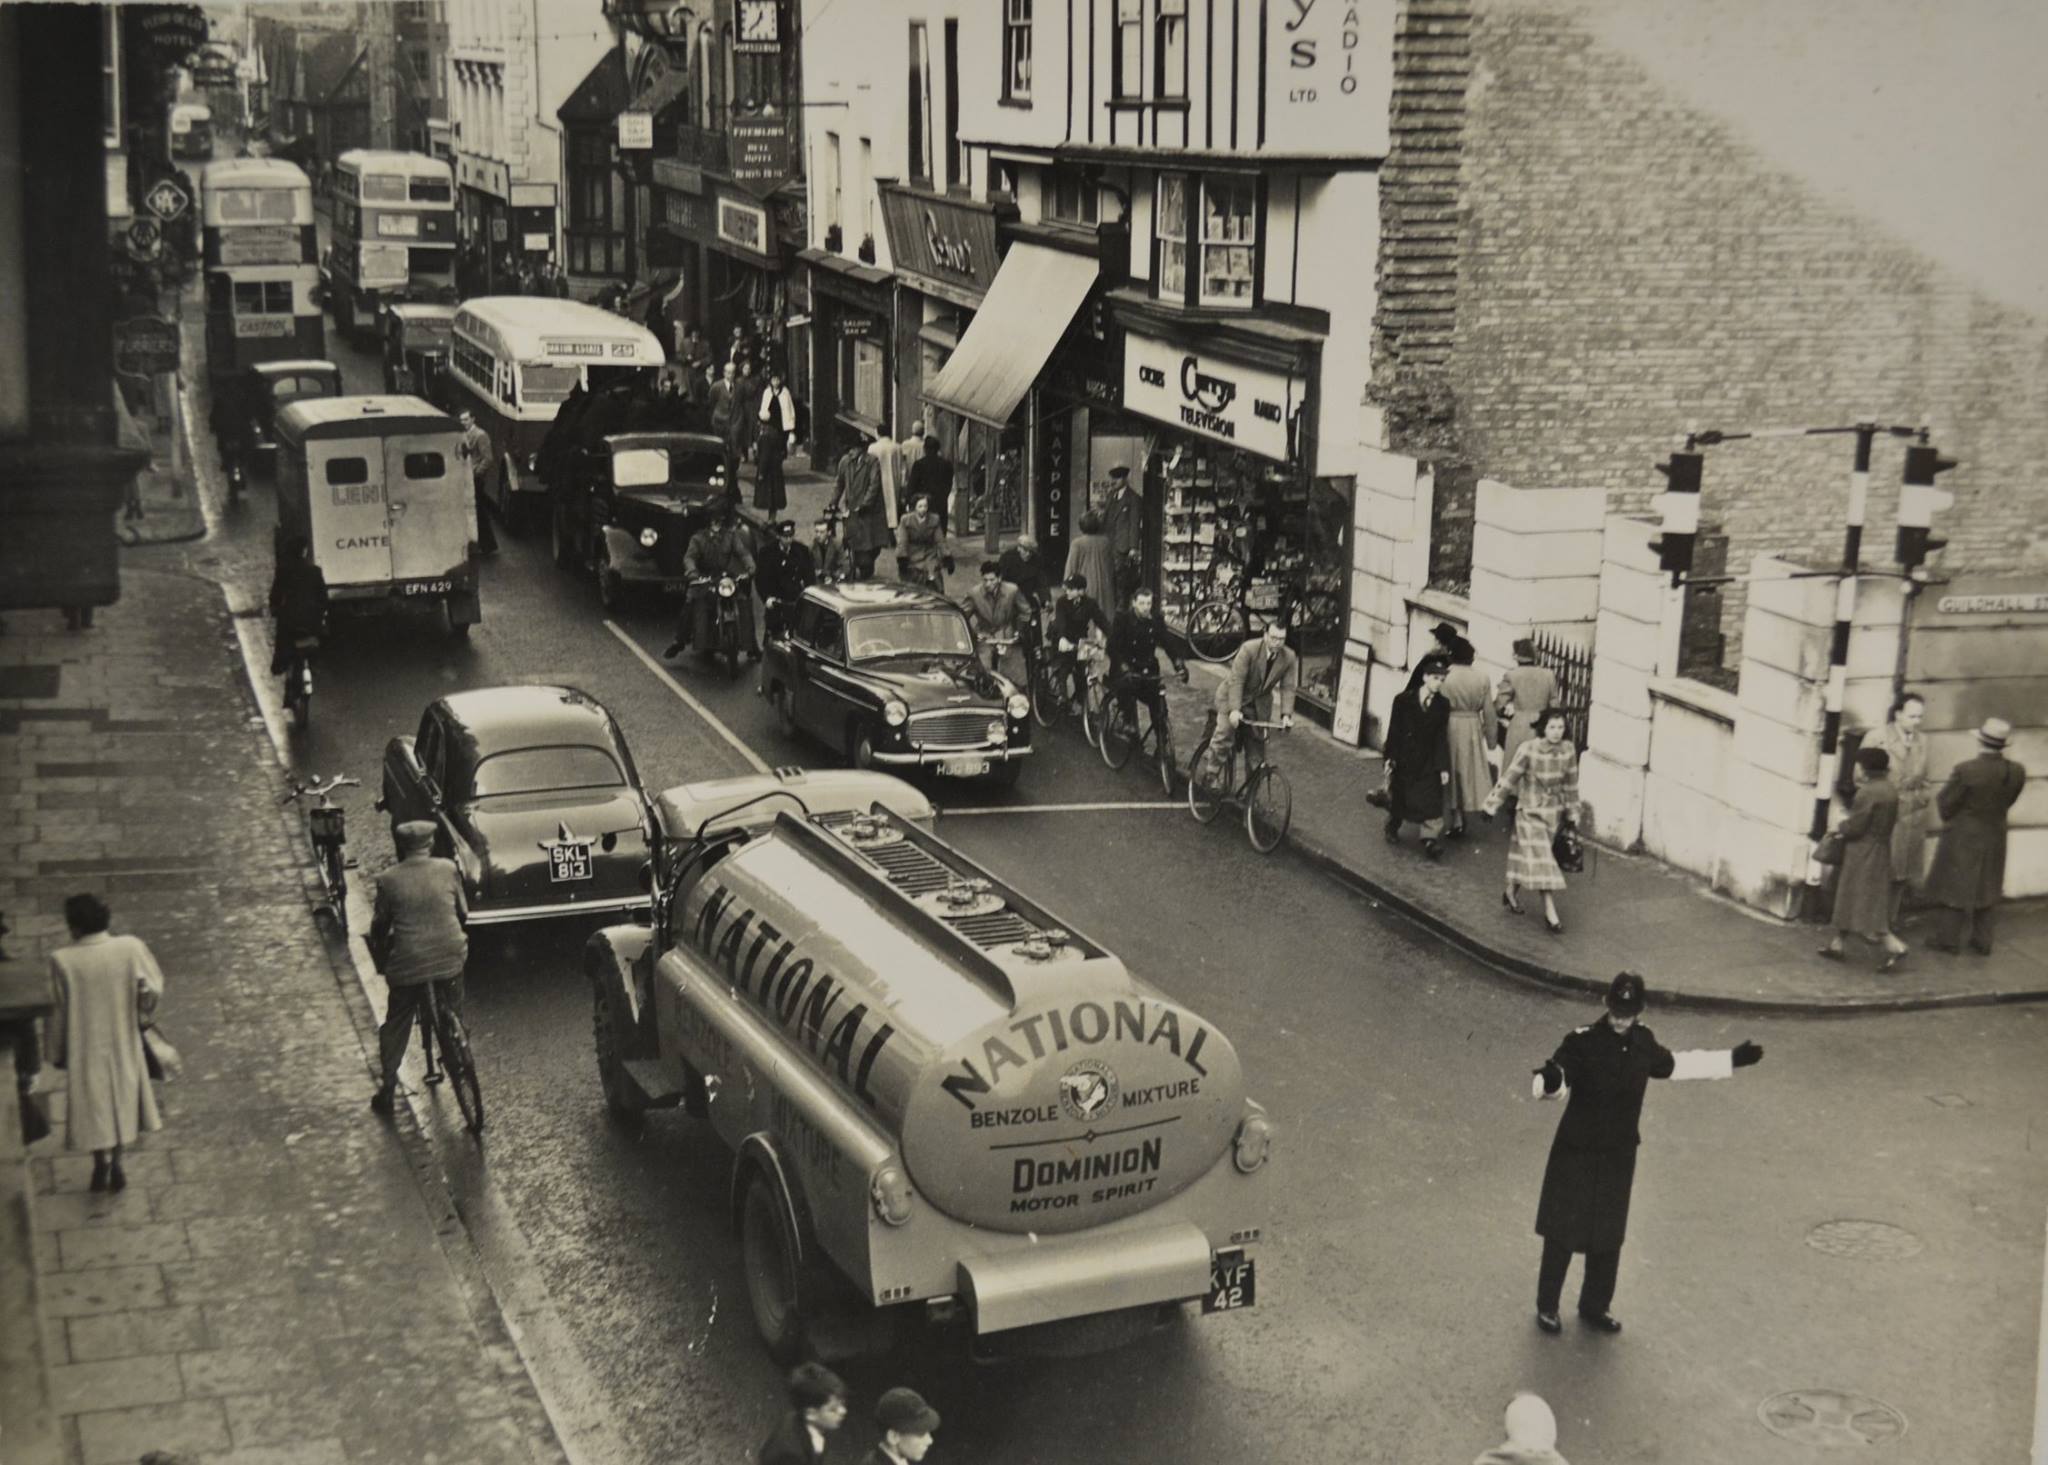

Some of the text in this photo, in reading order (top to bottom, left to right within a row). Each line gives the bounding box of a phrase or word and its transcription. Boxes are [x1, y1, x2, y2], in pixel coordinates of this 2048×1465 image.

[1341, 0, 1359, 95] ADIO
[1289, 88, 1317, 103] LTD
[1180, 404, 1235, 439] TELEVISION
[1255, 398, 1282, 424] RADIO
[1050, 418, 1063, 537] MAYPOLE
[336, 536, 390, 550] CANTE
[1943, 598, 2024, 612] GUILDHALL
[553, 846, 587, 863] SKL
[558, 862, 585, 878] 813
[694, 884, 895, 1107] NATIONAL
[941, 1001, 1207, 1110] NATIONAL
[970, 1105, 1058, 1129] BENZOLE
[1122, 1078, 1200, 1108] MIXTURE
[1009, 1177, 1157, 1213] MOTOR SPIRIT
[1214, 1287, 1243, 1309] 42
